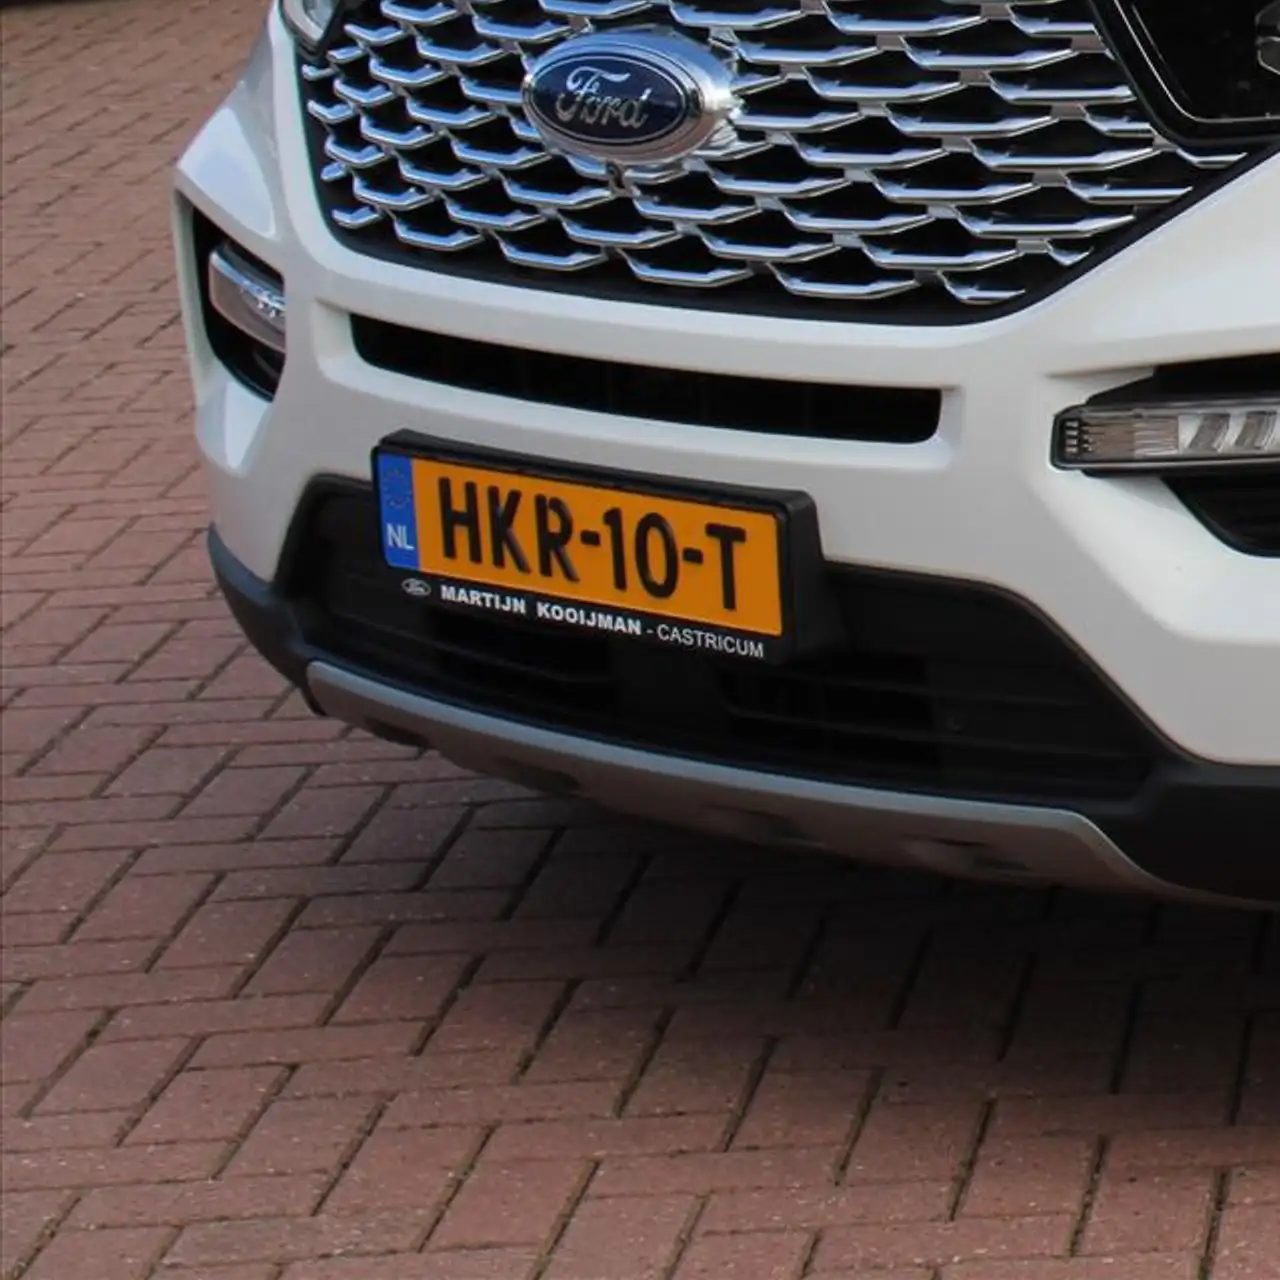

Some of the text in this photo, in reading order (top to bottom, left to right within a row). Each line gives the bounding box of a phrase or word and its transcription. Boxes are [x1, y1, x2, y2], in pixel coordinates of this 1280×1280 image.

[555, 65, 654, 130] Ford
[386, 523, 415, 551] NL
[437, 476, 747, 612] HKR-10-T
[440, 584, 527, 615] MARTIJN
[536, 602, 642, 636] KOOIJMAN
[656, 623, 765, 659] CASTRICUM
